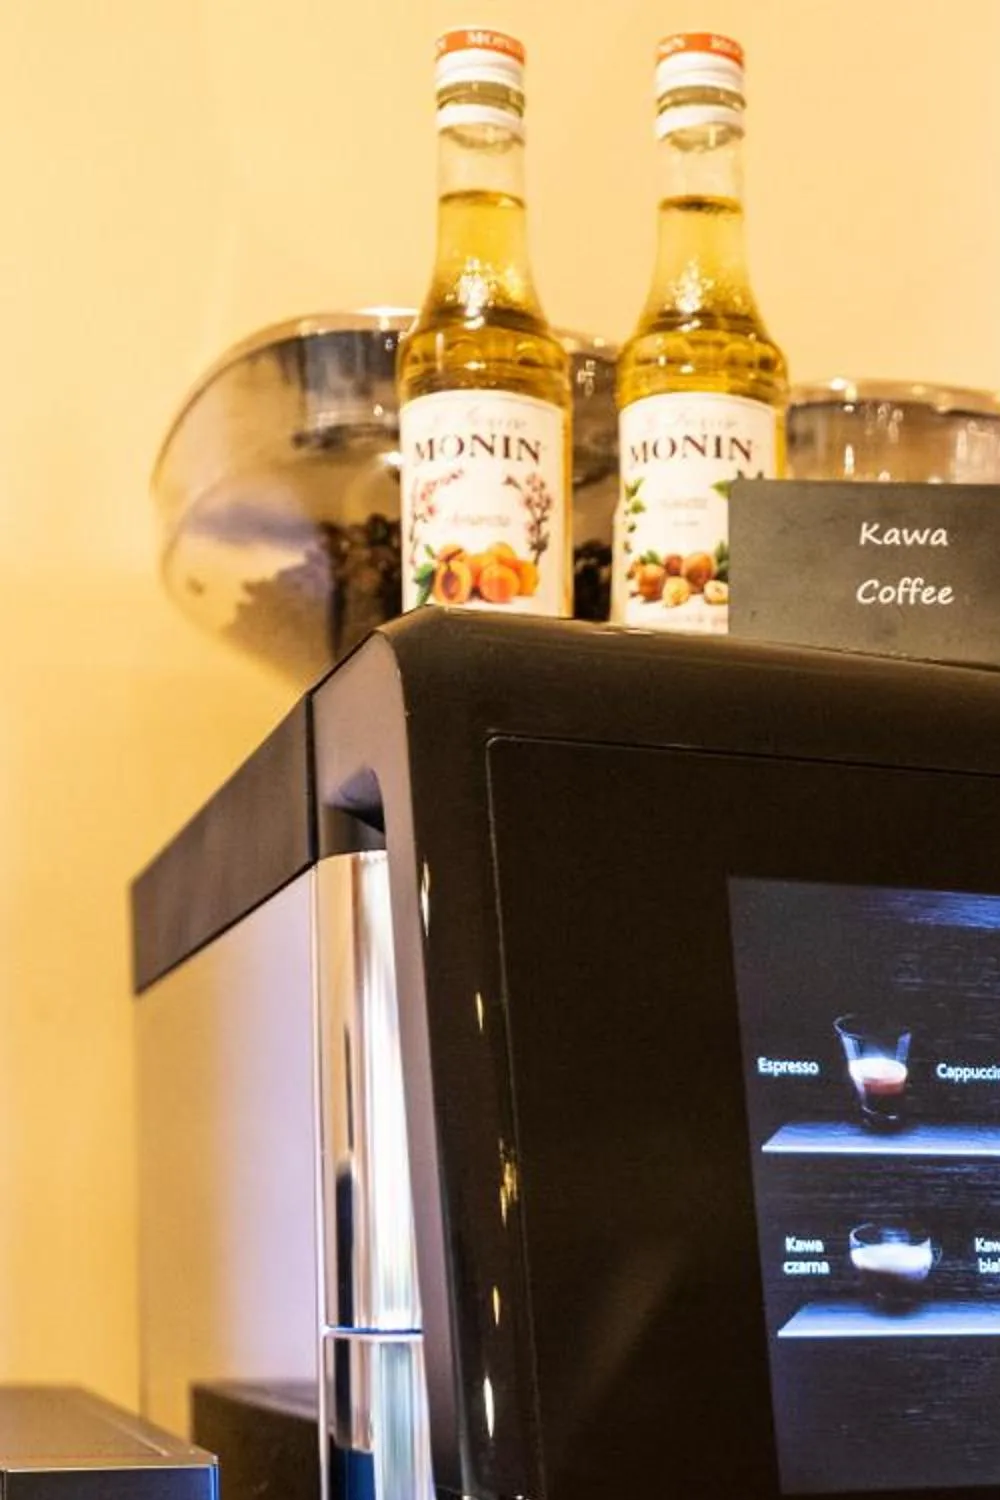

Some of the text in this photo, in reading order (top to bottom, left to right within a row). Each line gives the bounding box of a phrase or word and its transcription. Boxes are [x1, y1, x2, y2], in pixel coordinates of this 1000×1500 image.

[415, 434, 541, 465] MONIN
[629, 433, 753, 465] MONIN
[859, 521, 950, 548] Kawa
[856, 576, 955, 607] Coffee
[757, 1056, 819, 1076] Espresso
[785, 1235, 824, 1252] Kawa
[783, 1261, 830, 1275] czarna
